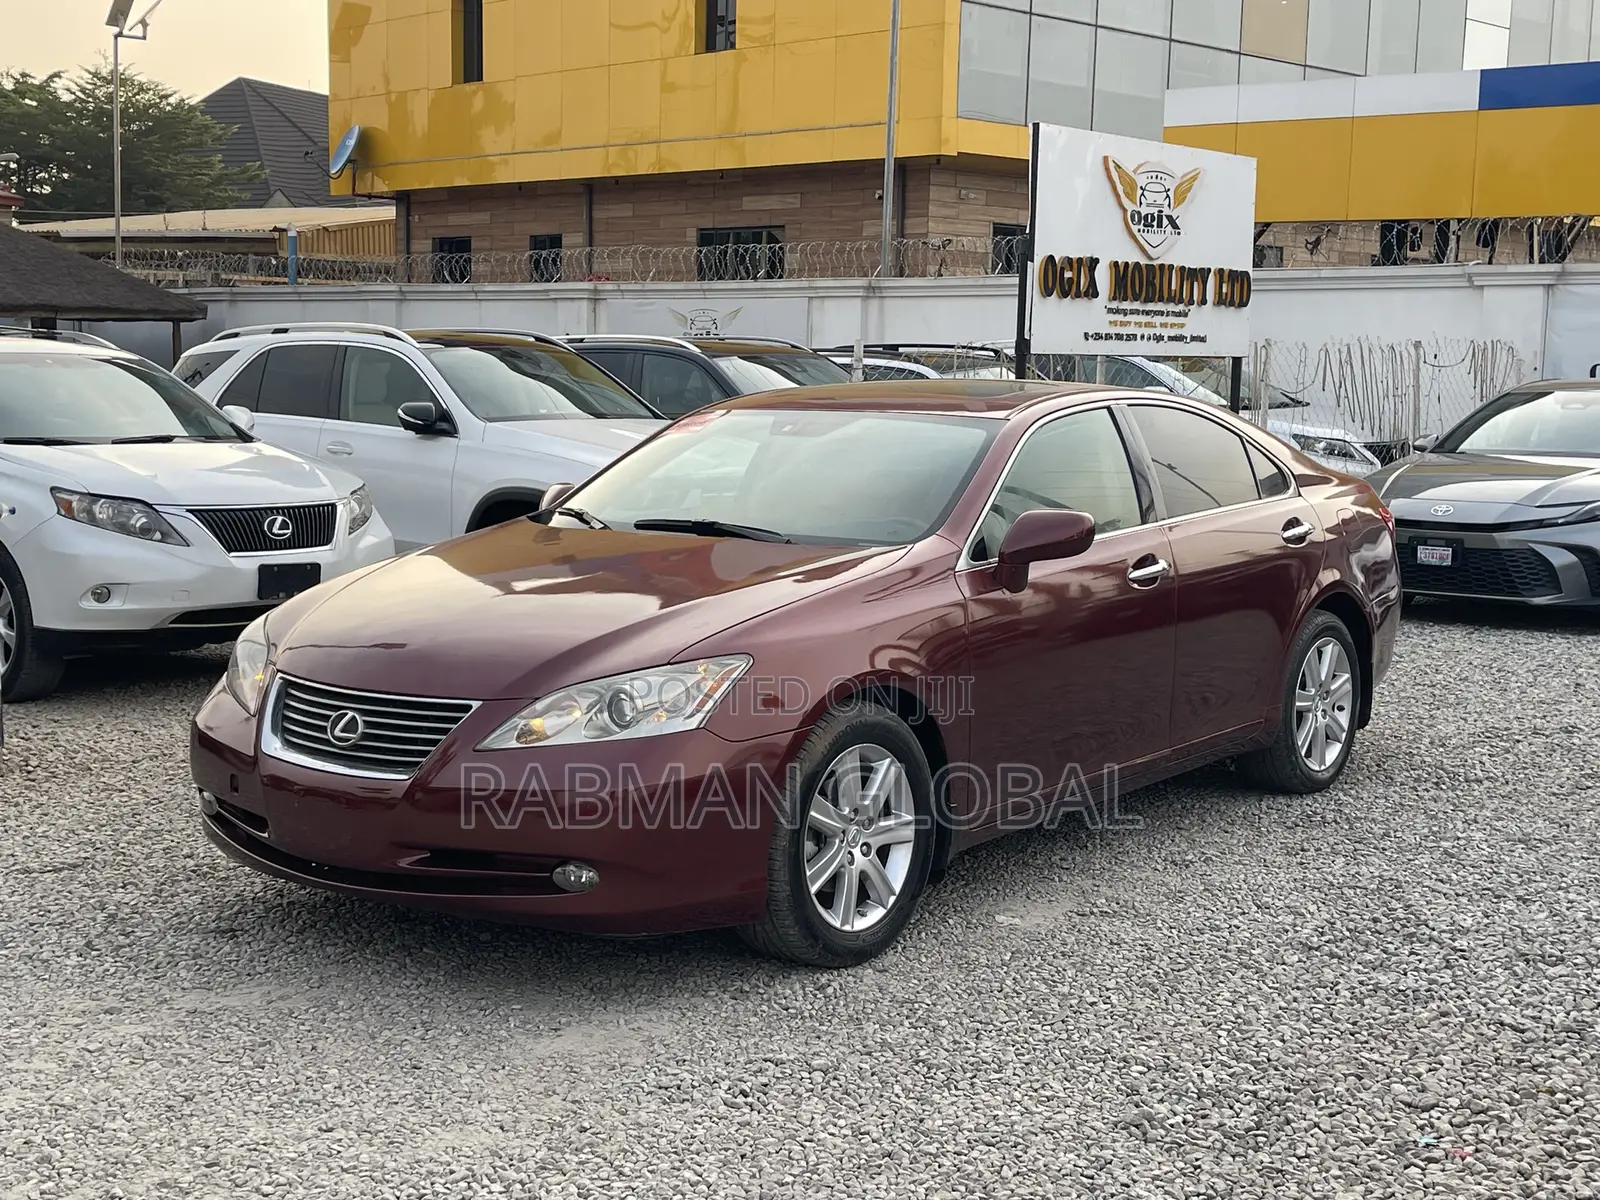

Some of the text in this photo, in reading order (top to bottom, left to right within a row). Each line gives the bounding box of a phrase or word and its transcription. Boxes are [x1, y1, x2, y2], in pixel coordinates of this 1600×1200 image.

[1130, 209, 1181, 230] Ogix
[1039, 254, 1252, 308] OGIX MOBILITY LTD
